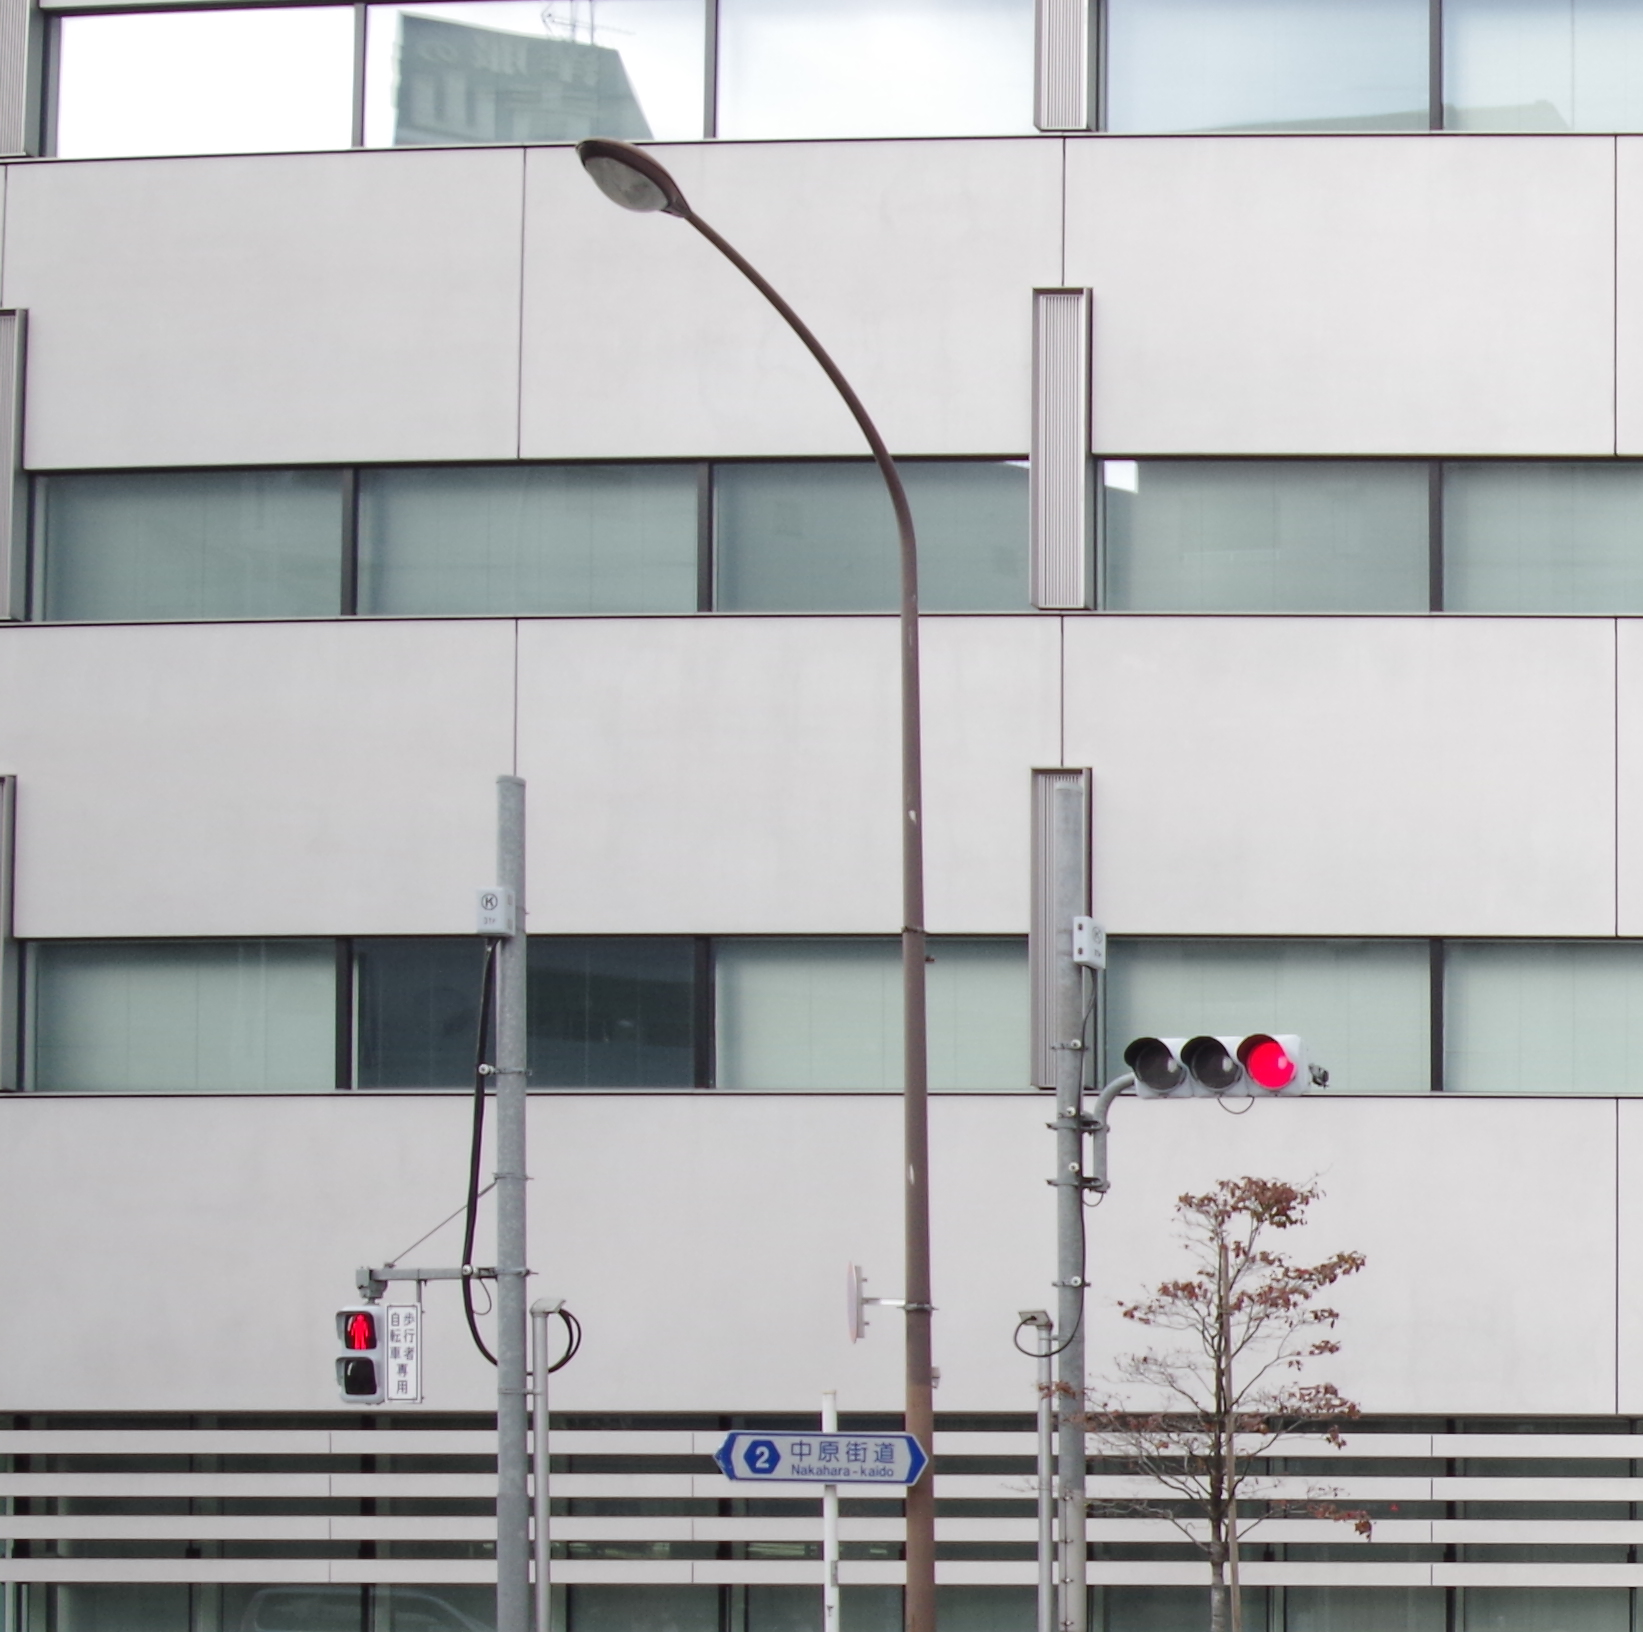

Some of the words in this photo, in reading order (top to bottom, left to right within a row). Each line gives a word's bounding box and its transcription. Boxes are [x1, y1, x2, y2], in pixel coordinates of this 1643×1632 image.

[390, 1312, 401, 1360] 自転車
[403, 1312, 415, 1361] 歩行者
[396, 1363, 408, 1394] 専用
[754, 1446, 770, 1469] 2
[790, 1440, 895, 1464] 中原街道
